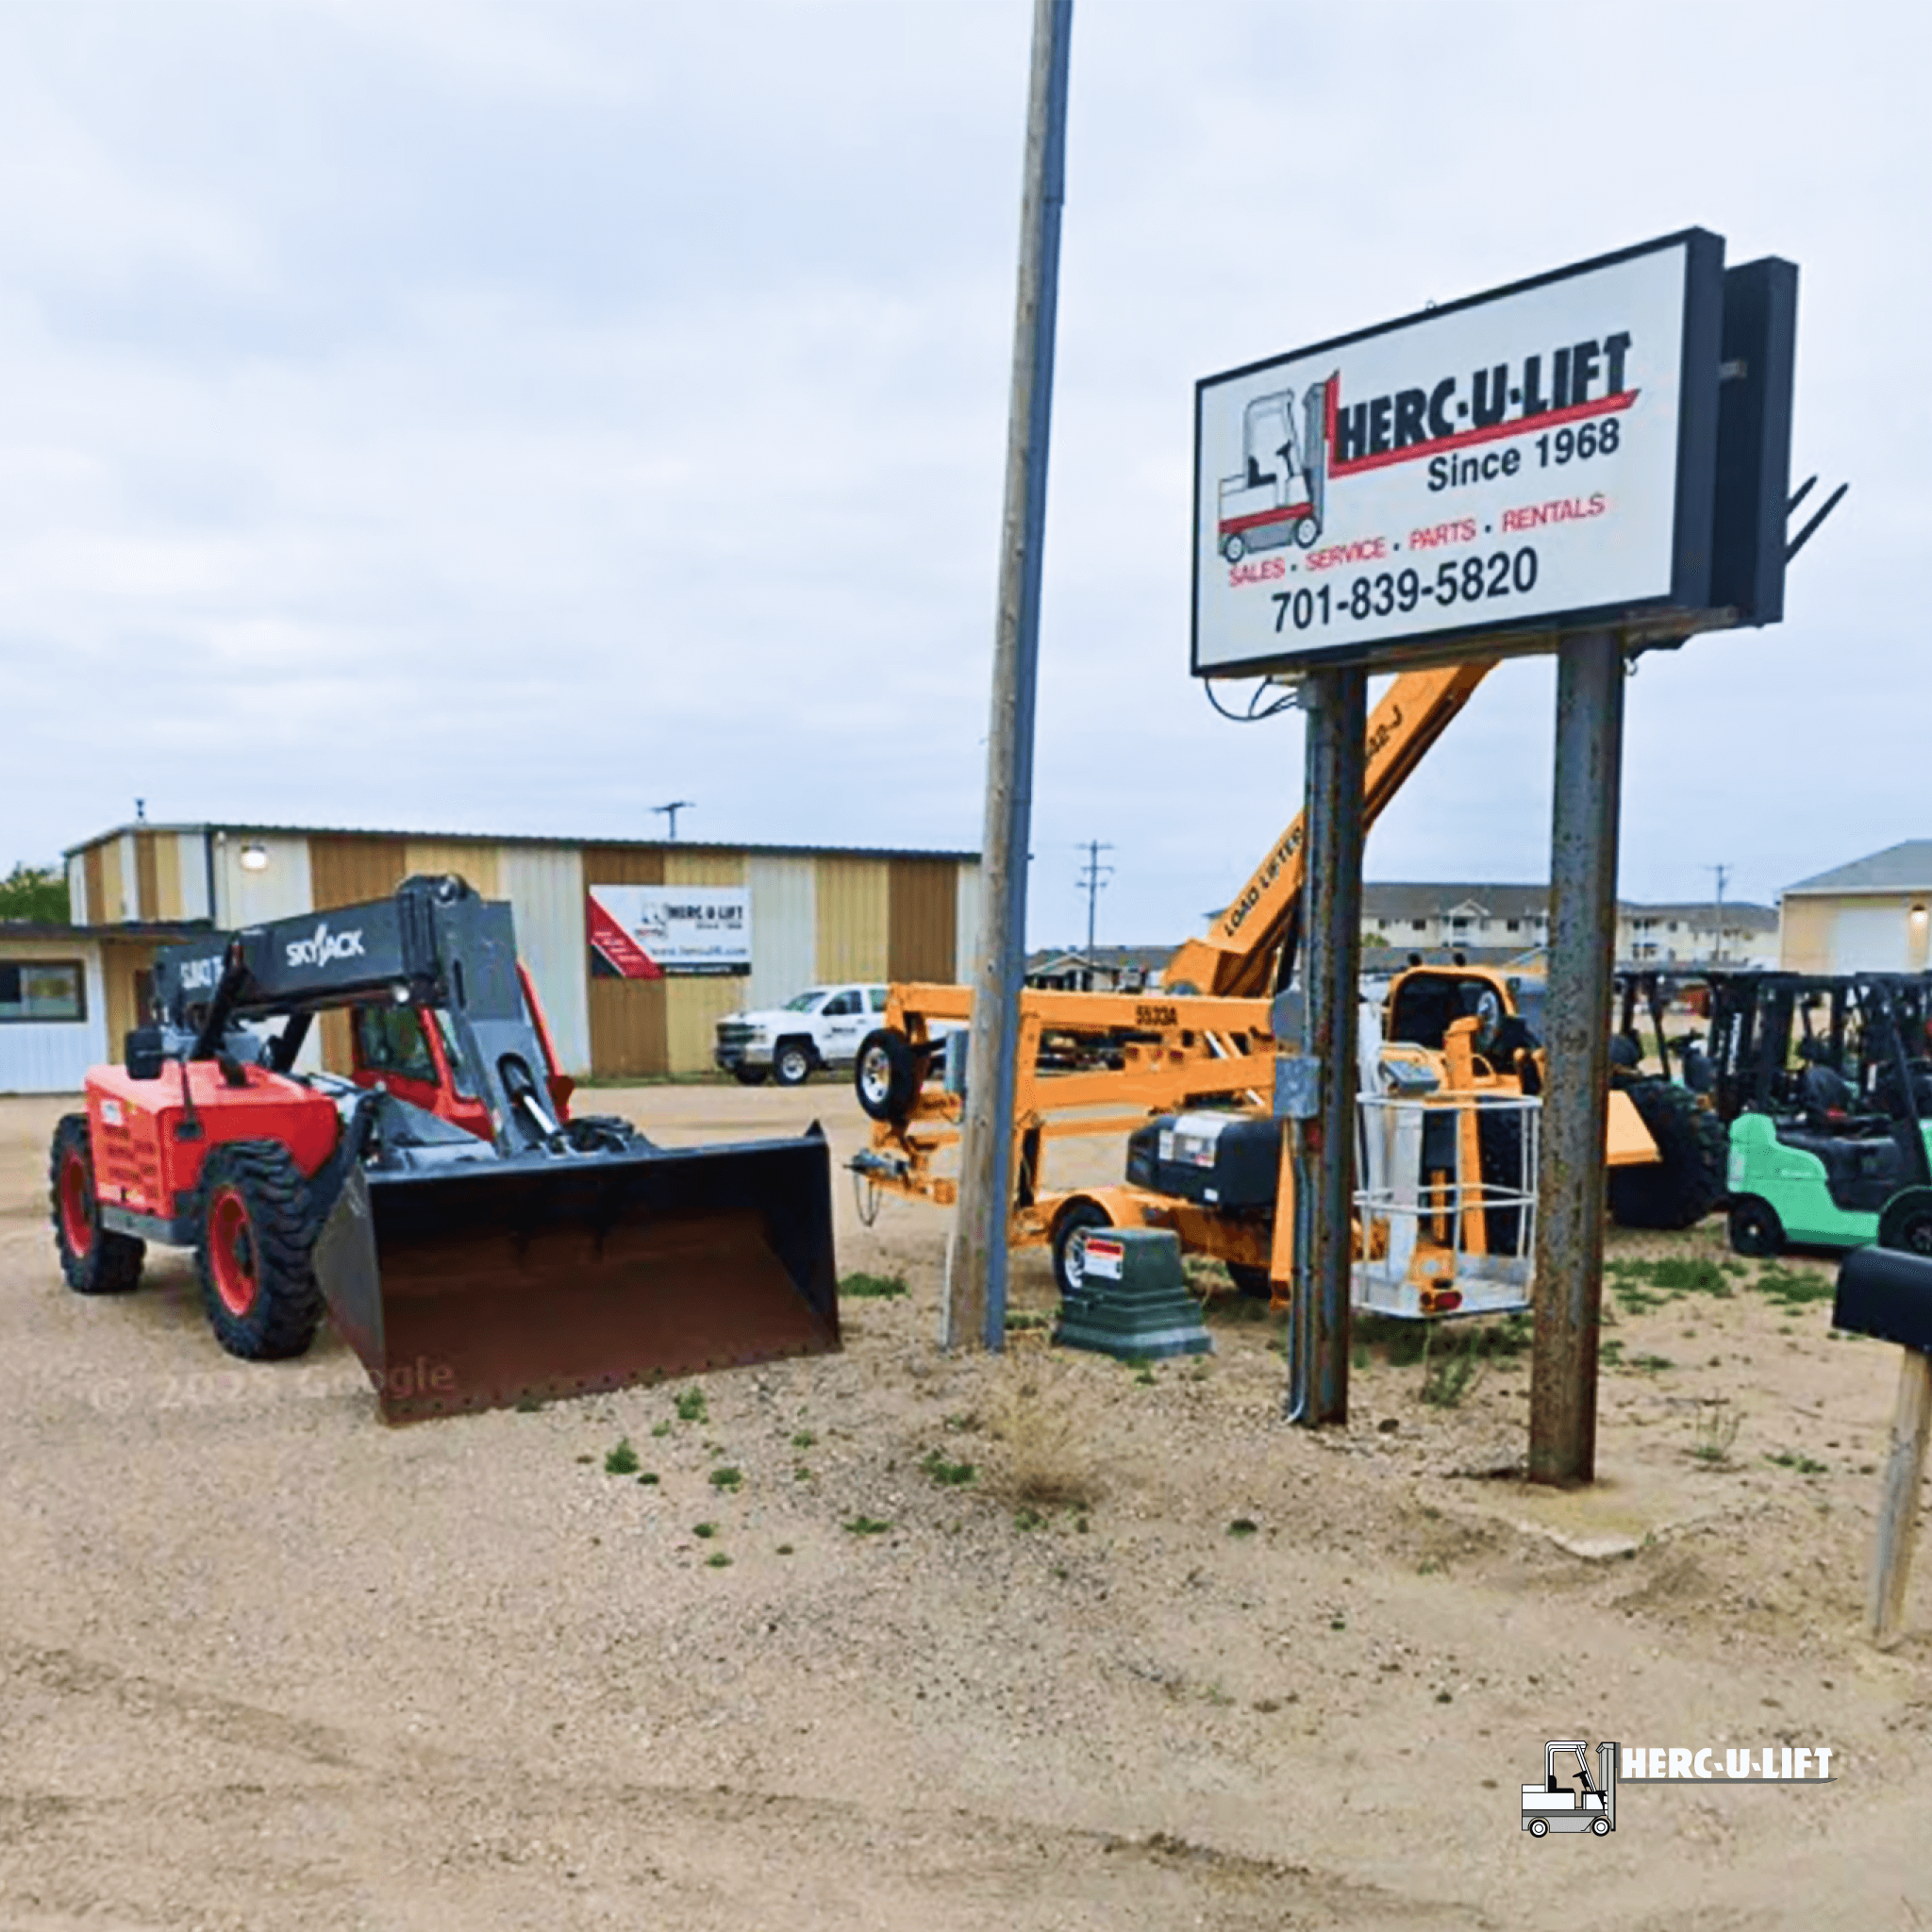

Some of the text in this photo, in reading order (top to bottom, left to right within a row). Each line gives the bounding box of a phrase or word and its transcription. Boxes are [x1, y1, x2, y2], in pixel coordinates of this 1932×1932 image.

[1427, 418, 1621, 491] Since 1968
[1229, 492, 1607, 588] SALES SERVICE PARTS RENTALS
[1271, 546, 1539, 634] 701-839-5820
[286, 924, 366, 968] SKYJACK
[1224, 885, 1260, 937] LOAD
